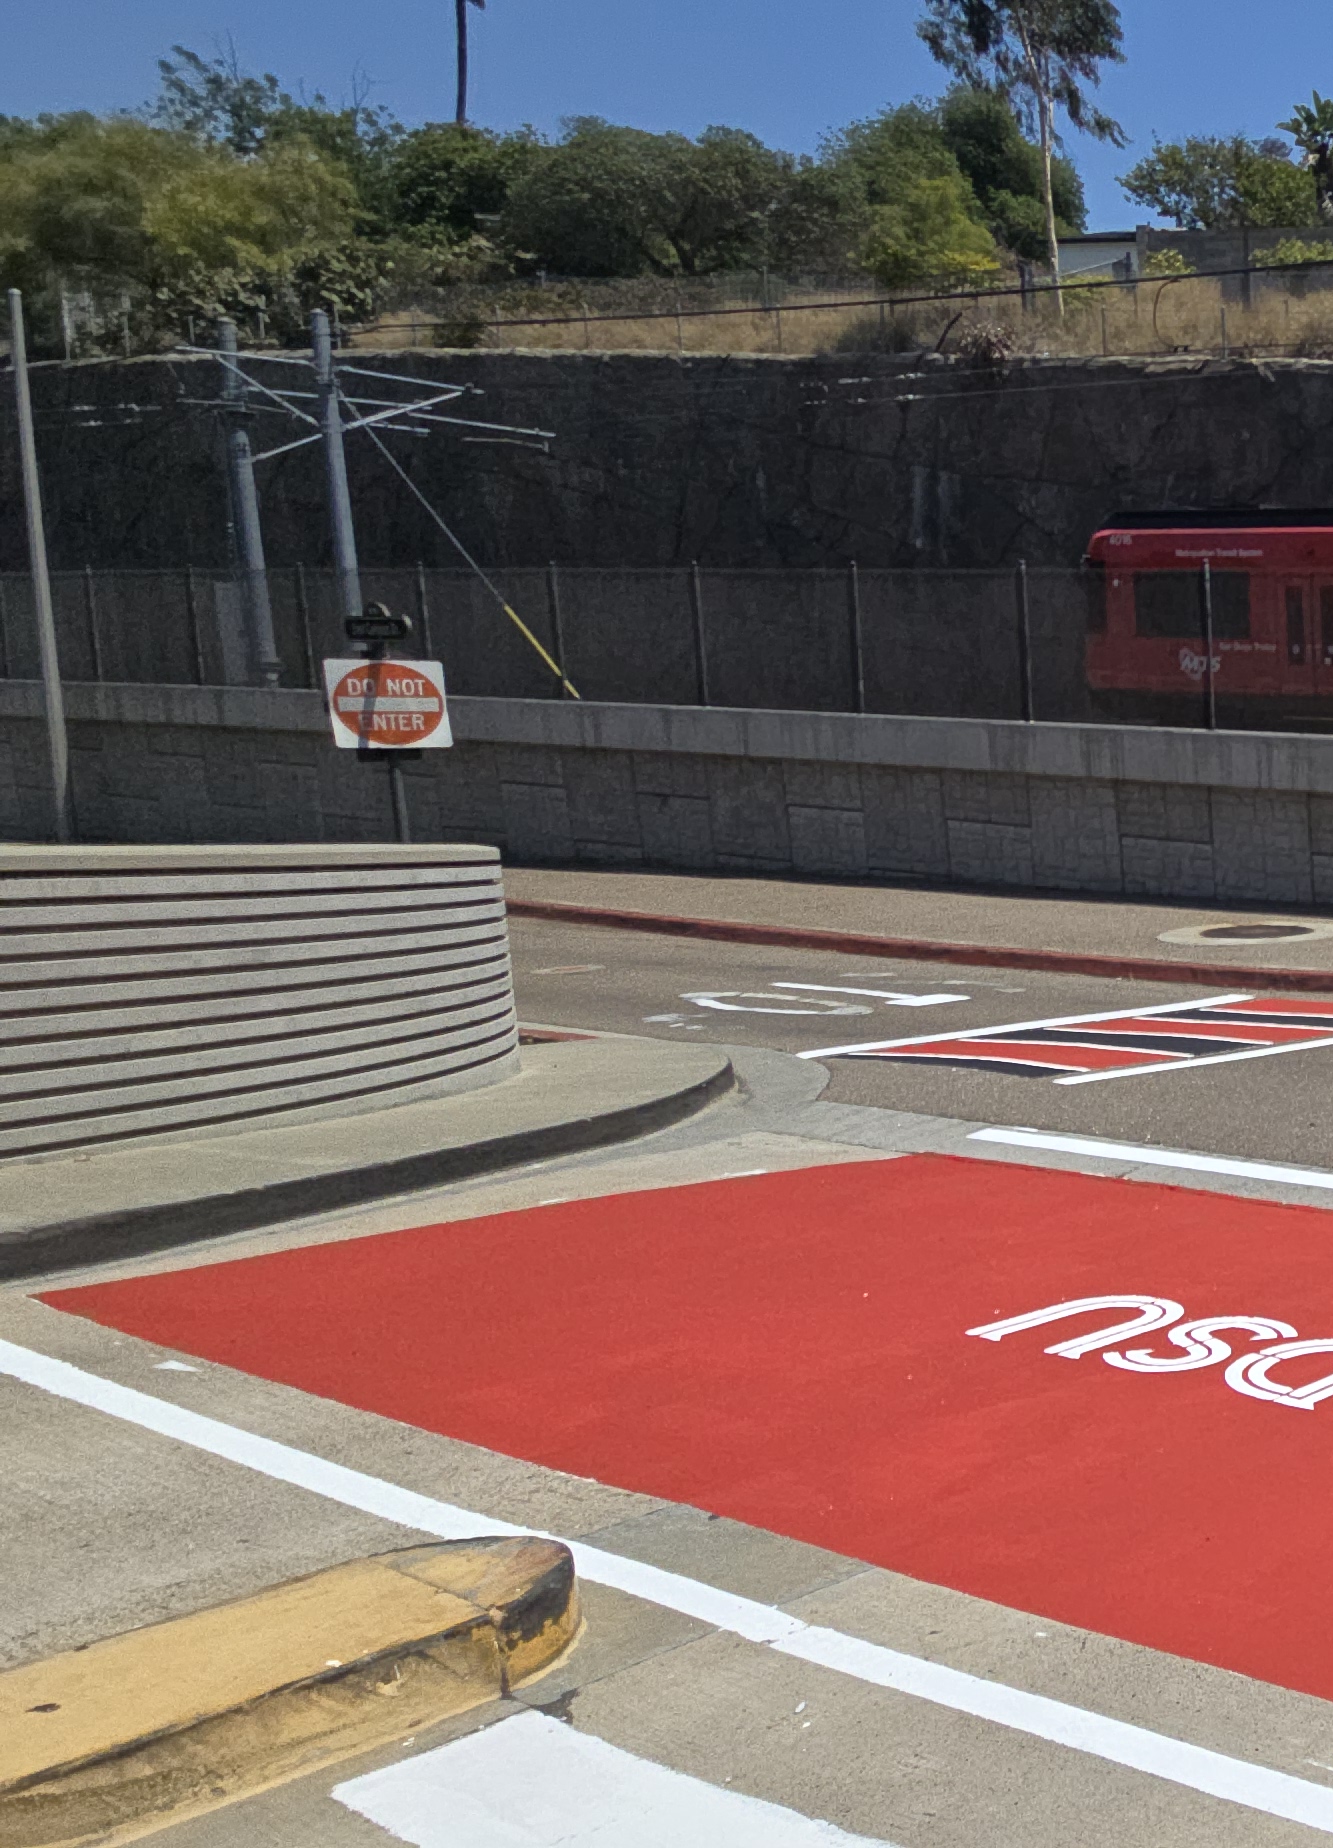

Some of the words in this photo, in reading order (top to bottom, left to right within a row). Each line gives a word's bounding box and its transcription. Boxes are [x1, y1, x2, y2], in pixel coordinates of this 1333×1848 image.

[347, 678, 376, 696] DO
[386, 678, 425, 696] NOT
[358, 713, 425, 731] ENTER
